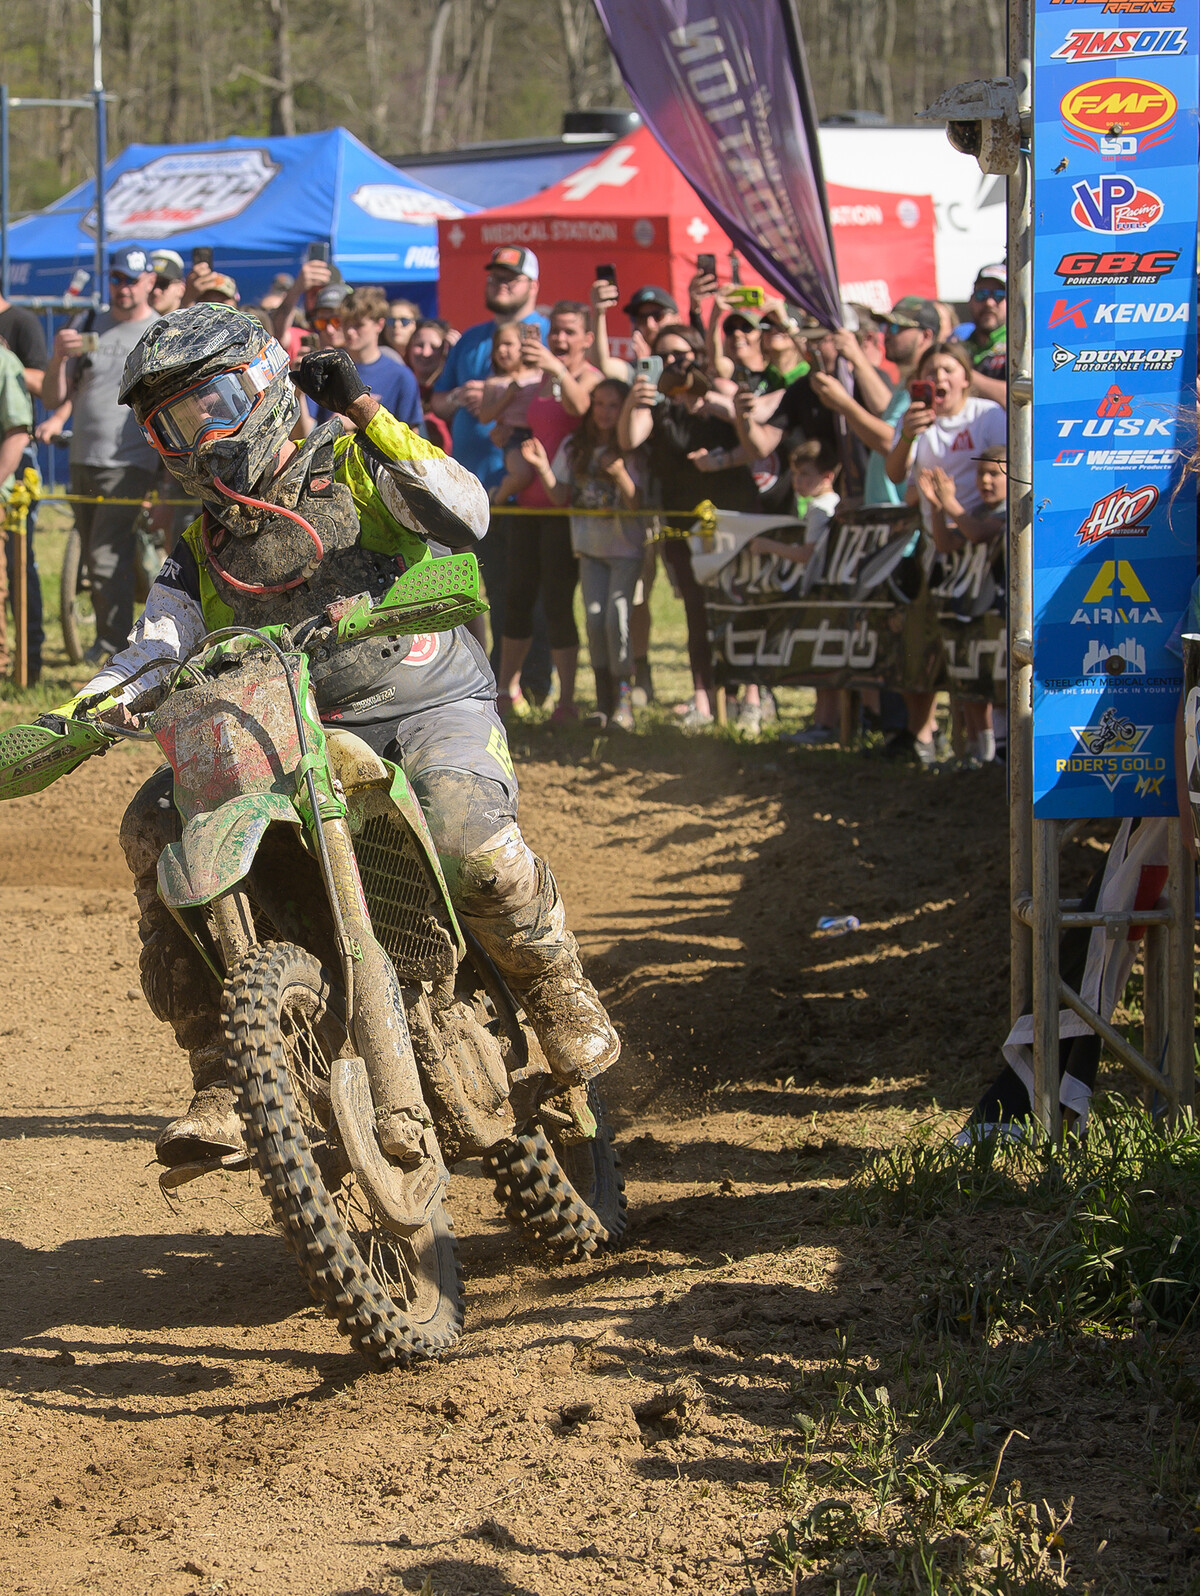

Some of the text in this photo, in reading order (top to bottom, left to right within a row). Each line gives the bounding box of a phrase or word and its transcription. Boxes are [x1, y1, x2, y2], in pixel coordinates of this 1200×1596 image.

[1103, 2, 1172, 13] RACING
[1058, 31, 1183, 59] AMSOIL
[1070, 93, 1167, 114] FMF
[1100, 136, 1138, 155] 50
[1076, 178, 1135, 231] VP
[1116, 204, 1162, 221] Racing
[1057, 252, 1179, 274] GBC
[1066, 276, 1157, 285] POWERSPORTS TIRES
[1093, 302, 1190, 323] KENDA
[1078, 349, 1183, 364] DUNLOP
[1072, 362, 1174, 371] MOTORCYCLE TIRES
[1056, 418, 1177, 438] TUSK
[1070, 607, 1164, 625] ARMA
[725, 619, 878, 668] turbo
[1044, 679, 1074, 687] STEEL
[1075, 678, 1097, 687] CITY
[1099, 678, 1144, 686] MEDICAL
[1056, 757, 1166, 772] RIDER'S GOLD
[1134, 773, 1166, 799] MX
